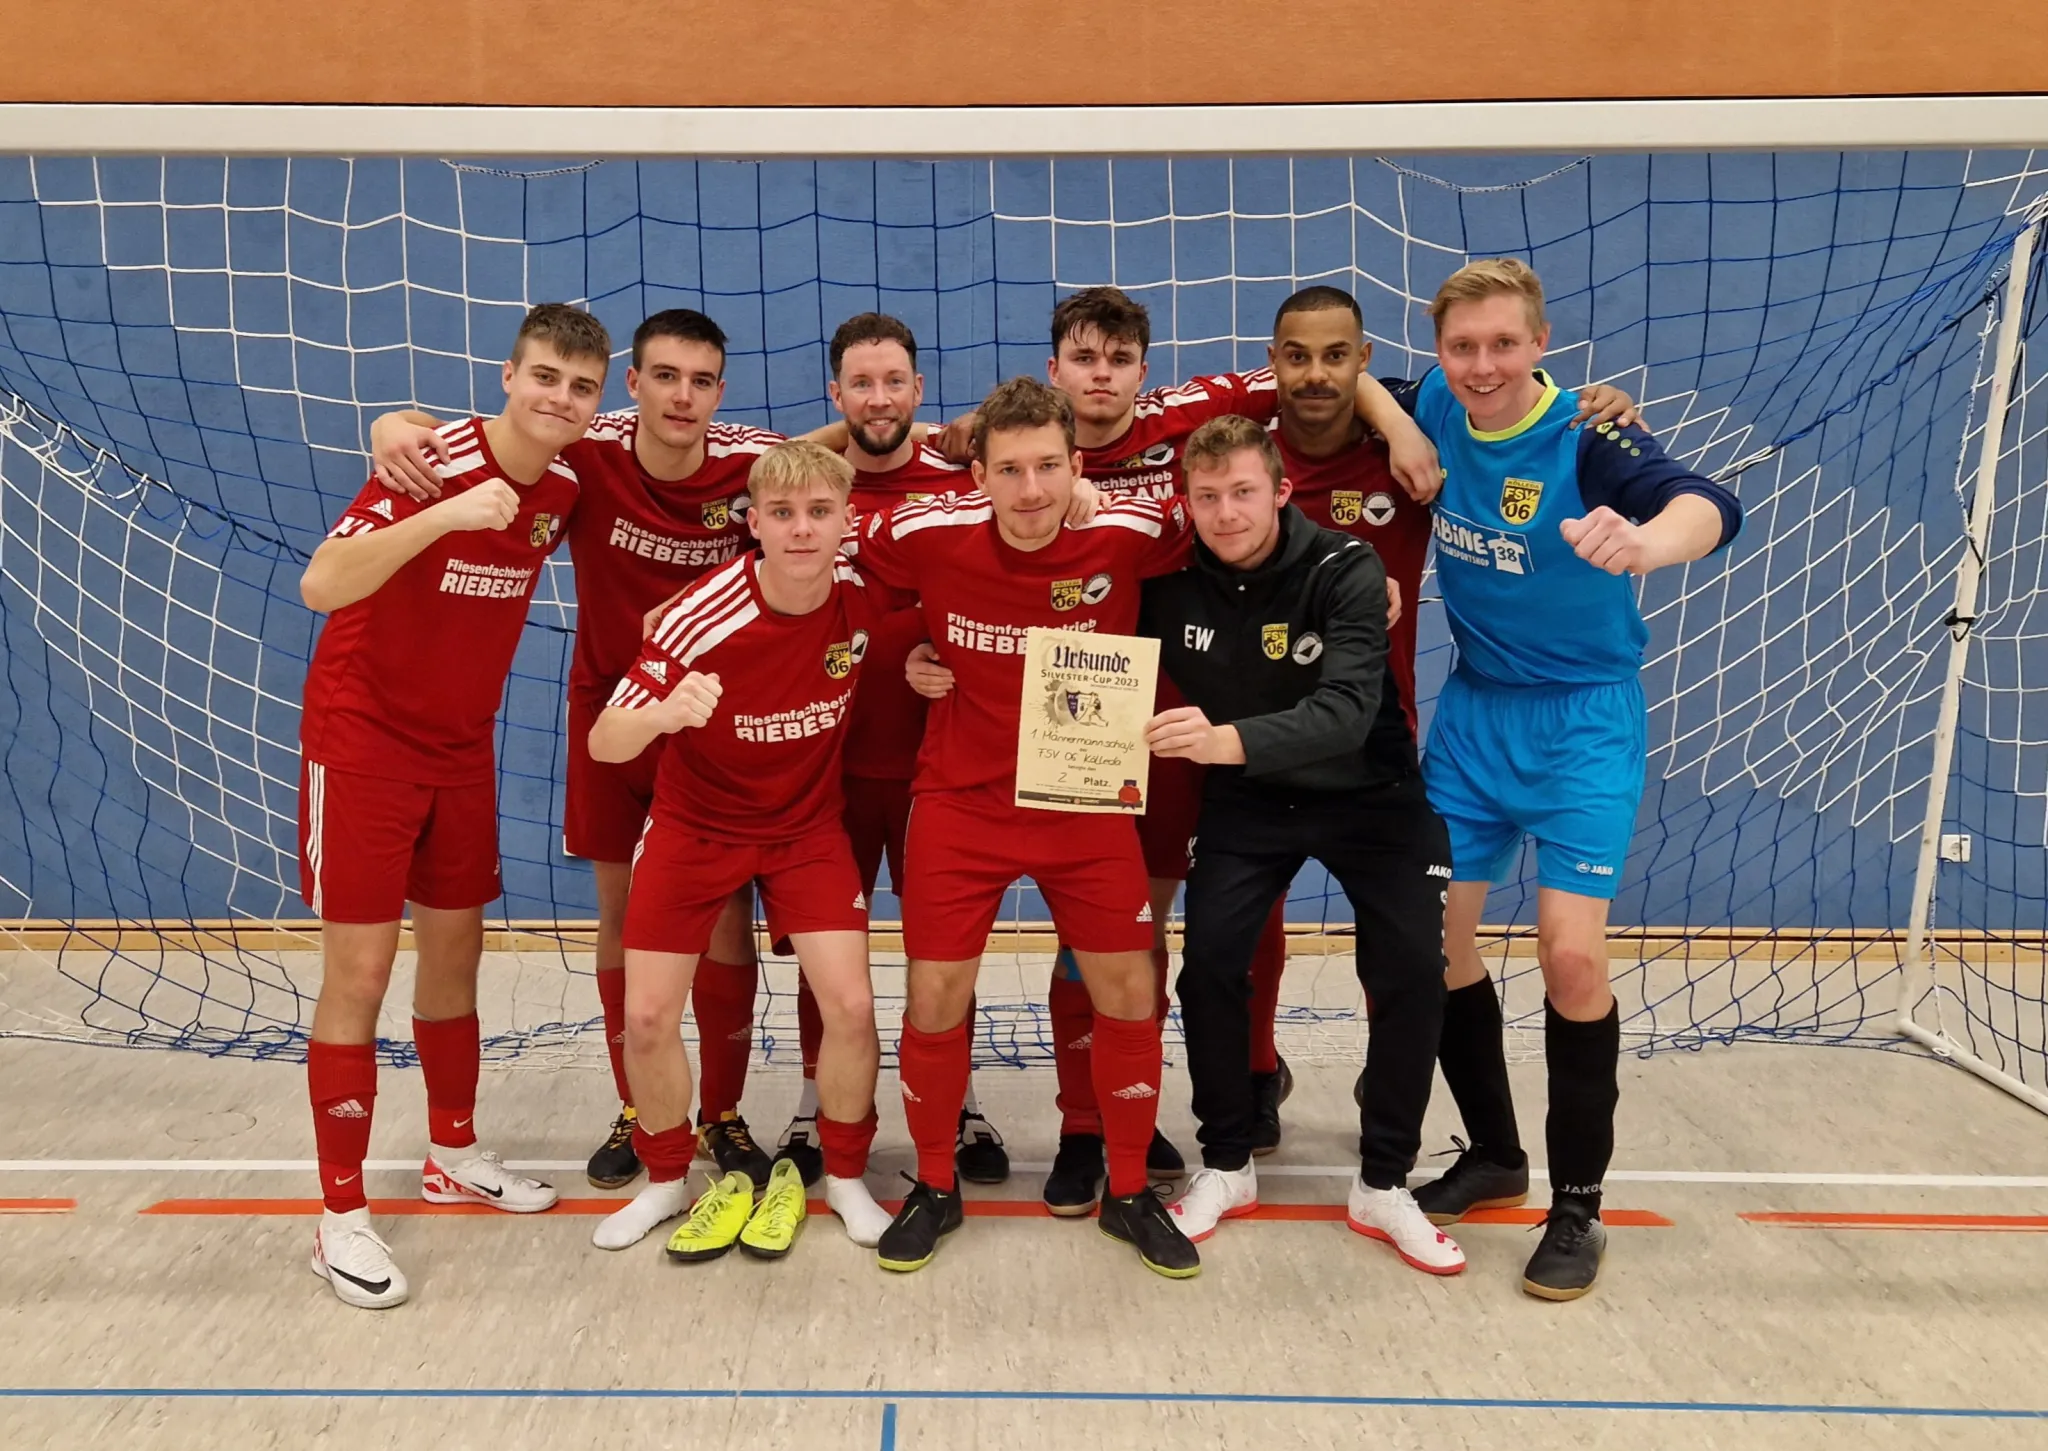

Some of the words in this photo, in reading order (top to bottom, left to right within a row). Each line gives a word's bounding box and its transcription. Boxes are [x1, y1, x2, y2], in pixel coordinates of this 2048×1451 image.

[1090, 470, 1174, 491] achbetrieb
[1505, 488, 1537, 501] FSV
[1333, 498, 1360, 507] FSV
[1335, 508, 1357, 521] 06
[1505, 502, 1531, 520] 06
[706, 513, 727, 528] 06
[1496, 545, 1518, 562] 38
[1053, 585, 1080, 597] FSV
[1055, 595, 1077, 609] 06
[1184, 623, 1215, 652] EW
[1264, 630, 1287, 641] FSV
[1267, 642, 1285, 655] 06
[826, 650, 850, 662] FSV
[1051, 645, 1131, 675] Urkunde
[829, 660, 850, 676] 06
[1114, 675, 1139, 688] 2023
[1038, 748, 1061, 759] FSV
[1057, 772, 1068, 783] 2
[1083, 776, 1113, 788] Platz.
[1426, 864, 1453, 880] JAKO
[1590, 866, 1614, 876] JAKO
[1111, 1089, 1157, 1100] adidas
[328, 1107, 368, 1119] adidas
[1561, 1183, 1600, 1195] JAKO
